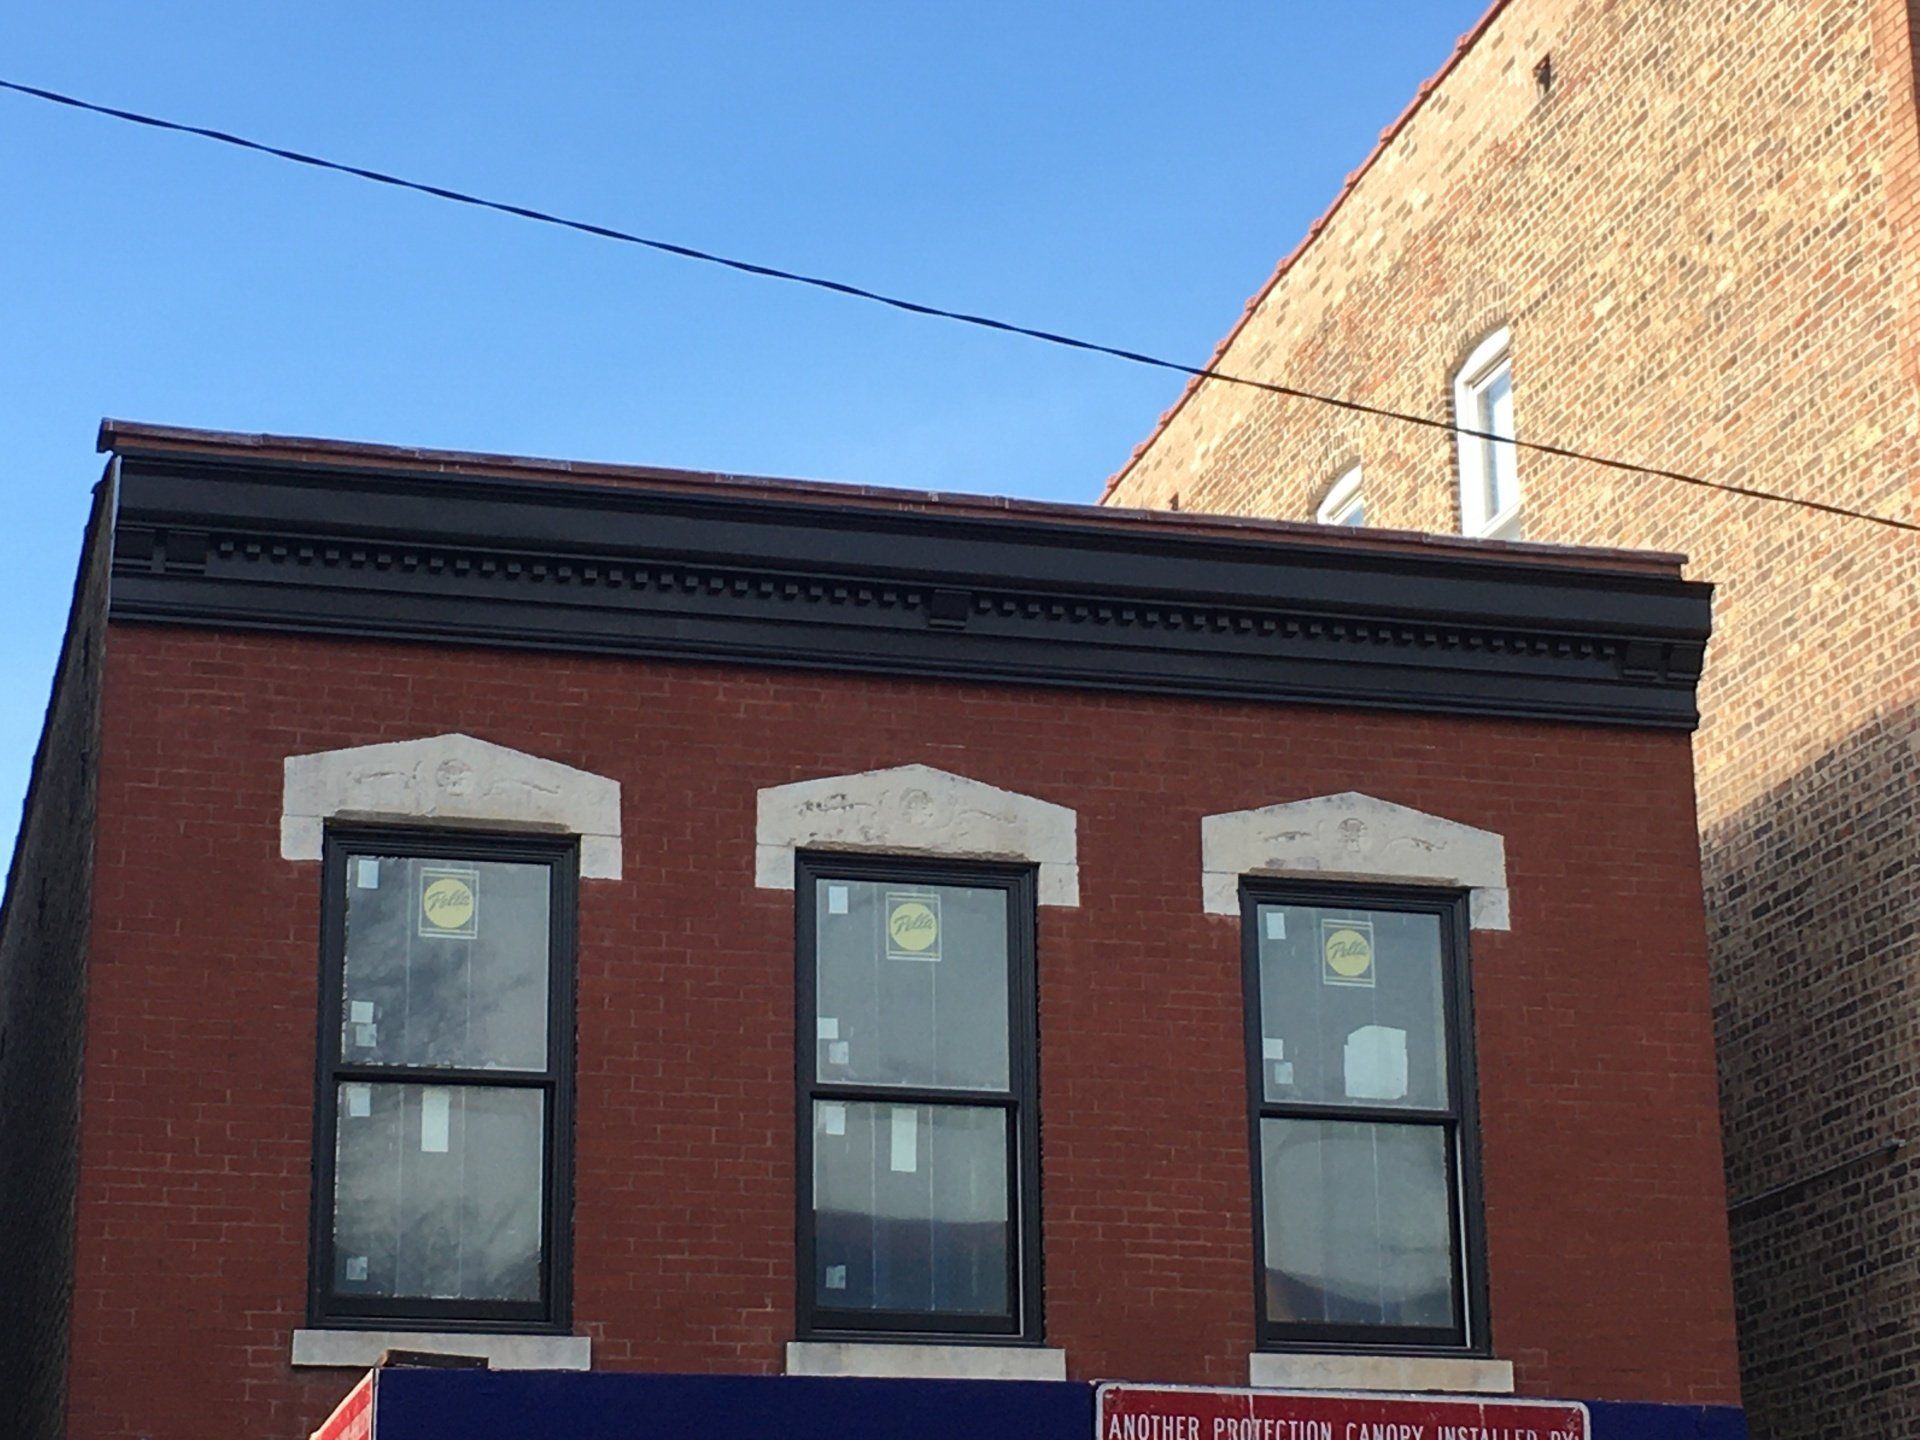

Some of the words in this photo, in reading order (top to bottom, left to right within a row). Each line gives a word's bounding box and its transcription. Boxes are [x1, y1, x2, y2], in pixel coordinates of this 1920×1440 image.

[1108, 1413, 1200, 1440] ANOTHER
[1213, 1417, 1332, 1440] PROTECTION
[1345, 1422, 1424, 1440] CANOPY
